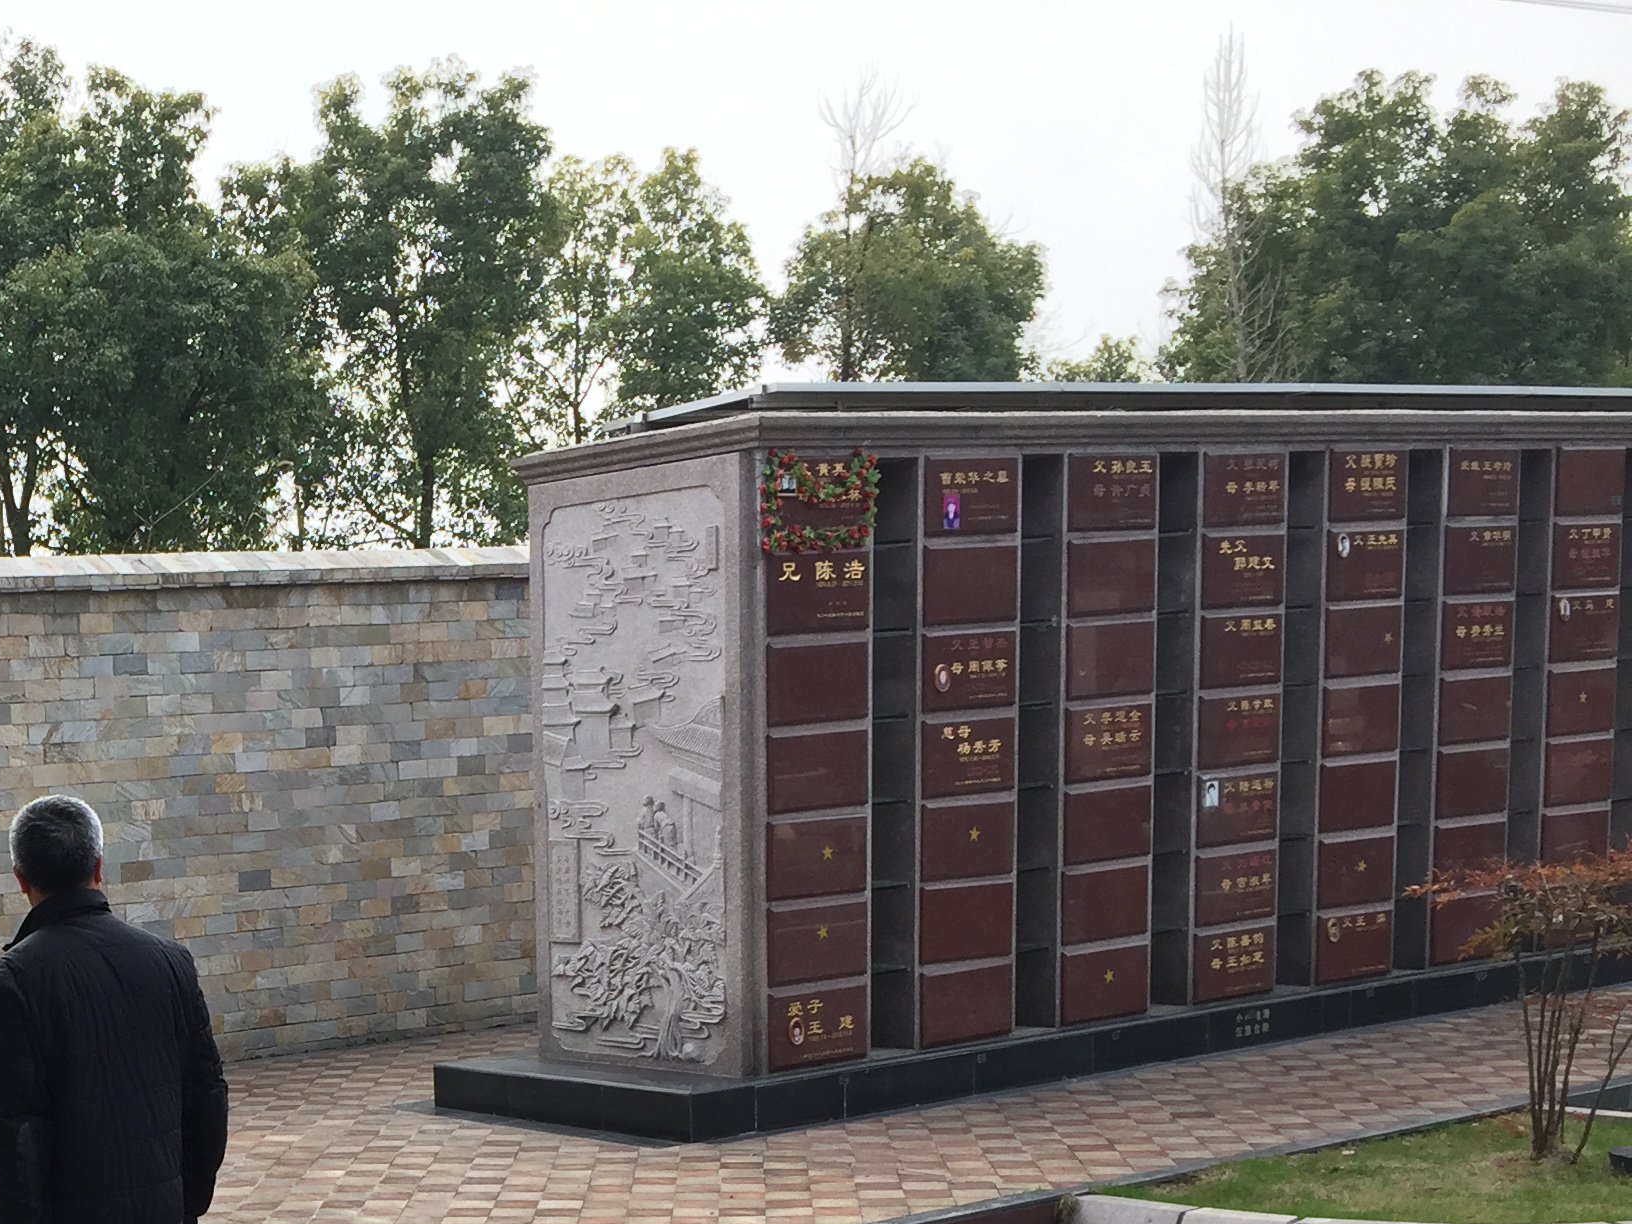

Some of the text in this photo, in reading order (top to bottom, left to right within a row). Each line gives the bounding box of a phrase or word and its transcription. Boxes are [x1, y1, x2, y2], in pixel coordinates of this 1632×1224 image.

[1093, 460, 1107, 473] 父
[1346, 455, 1357, 469] 父
[939, 471, 1010, 485] 曹荣华之墓
[1093, 484, 1106, 497] 母
[1226, 481, 1238, 494] 母
[1345, 478, 1356, 492] 母
[1354, 535, 1364, 545] 父
[1469, 532, 1480, 542] 父
[1569, 529, 1578, 539] 父
[779, 559, 866, 581] 兄 陈 浩
[1224, 621, 1236, 632] 父
[1455, 626, 1467, 639] 母
[951, 639, 964, 650] 父
[951, 662, 964, 674] 母
[1227, 701, 1238, 712] 父
[1084, 713, 1096, 725] 父
[942, 725, 971, 740] 慈母
[1083, 734, 1096, 747] 母
[957, 739, 1002, 755] 杨秀芳
[1221, 879, 1232, 891] 母
[1343, 918, 1354, 928] 父
[1354, 916, 1366, 926] 王
[1211, 938, 1223, 950] 父
[1211, 958, 1222, 970] 母
[788, 1000, 824, 1016] 爱子
[808, 1022, 824, 1034] 王
